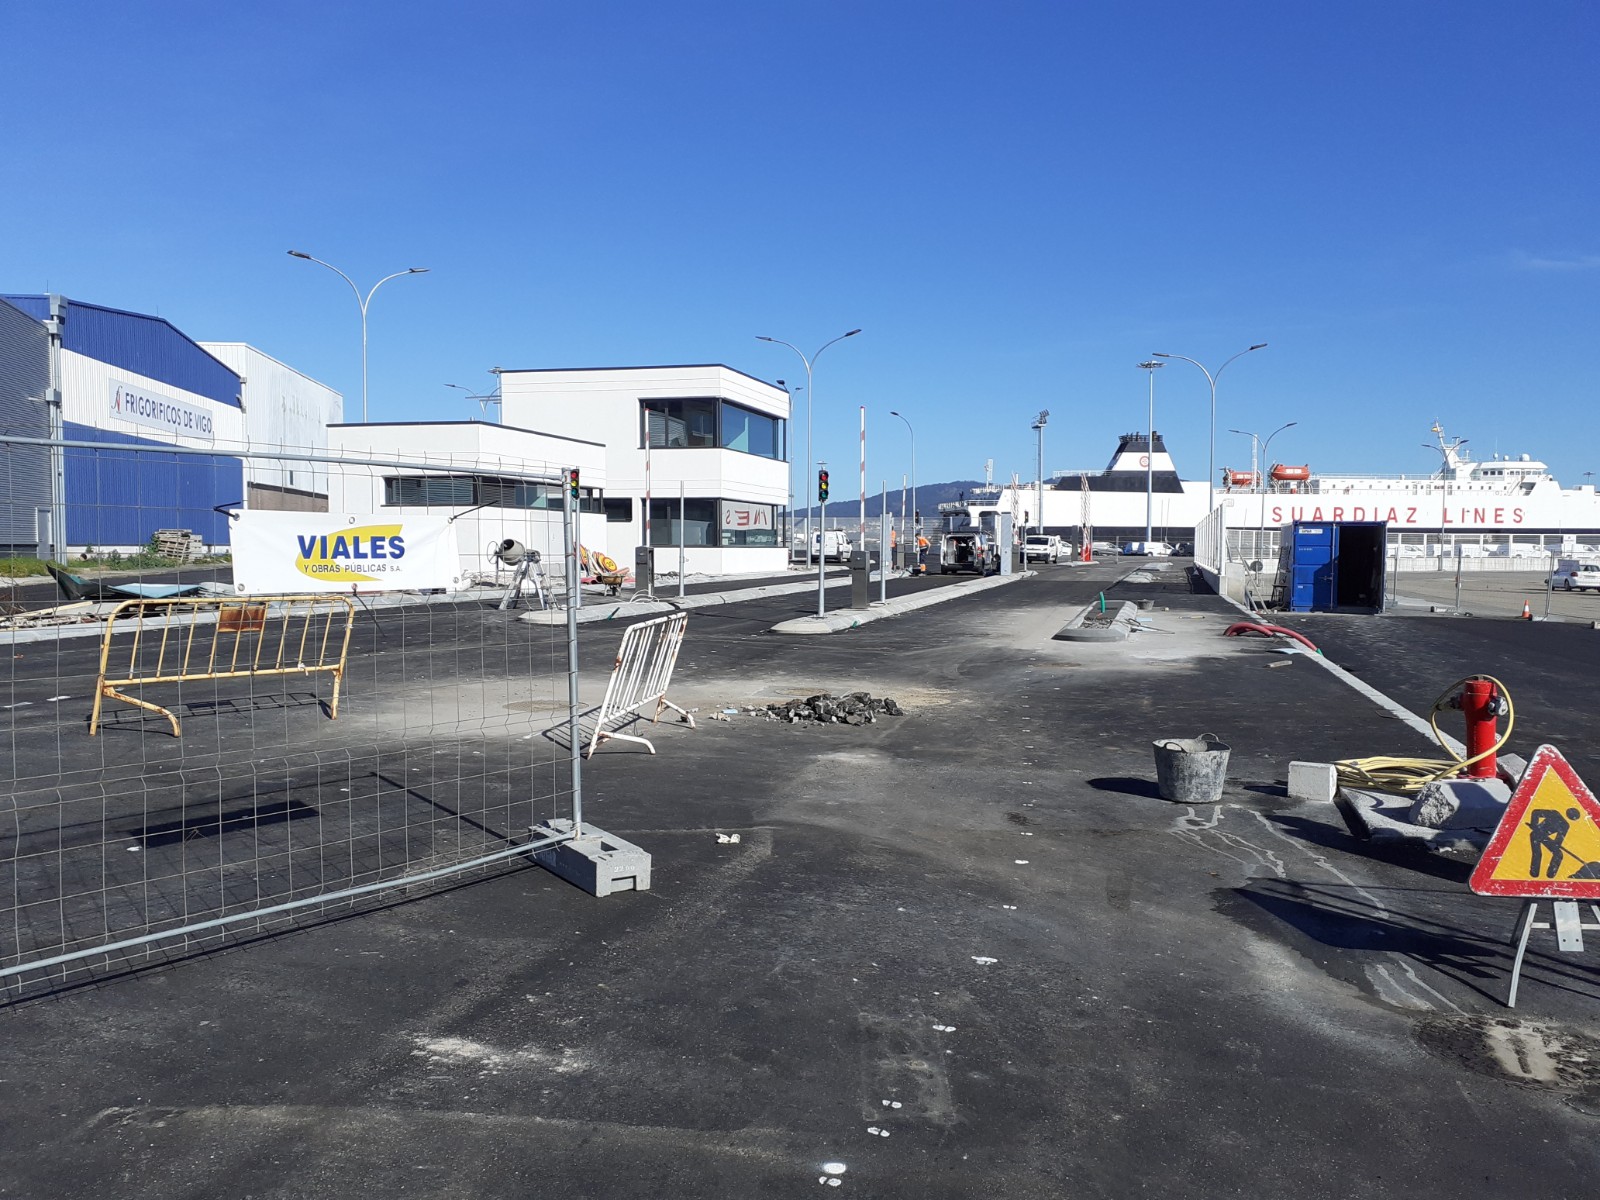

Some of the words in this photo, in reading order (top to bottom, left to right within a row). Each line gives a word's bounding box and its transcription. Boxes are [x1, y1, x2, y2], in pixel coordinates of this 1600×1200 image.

[125, 392, 181, 426] FRIGORIFICOS
[184, 411, 192, 428] DE
[195, 413, 211, 433] VIGO
[1272, 506, 1417, 523] SUARDIAZ
[1443, 507, 1523, 523] LINES
[297, 535, 405, 560] VIALES
[304, 564, 310, 573] Y
[311, 564, 340, 573] OBRAS
[344, 562, 387, 573] PÚBLICAS
